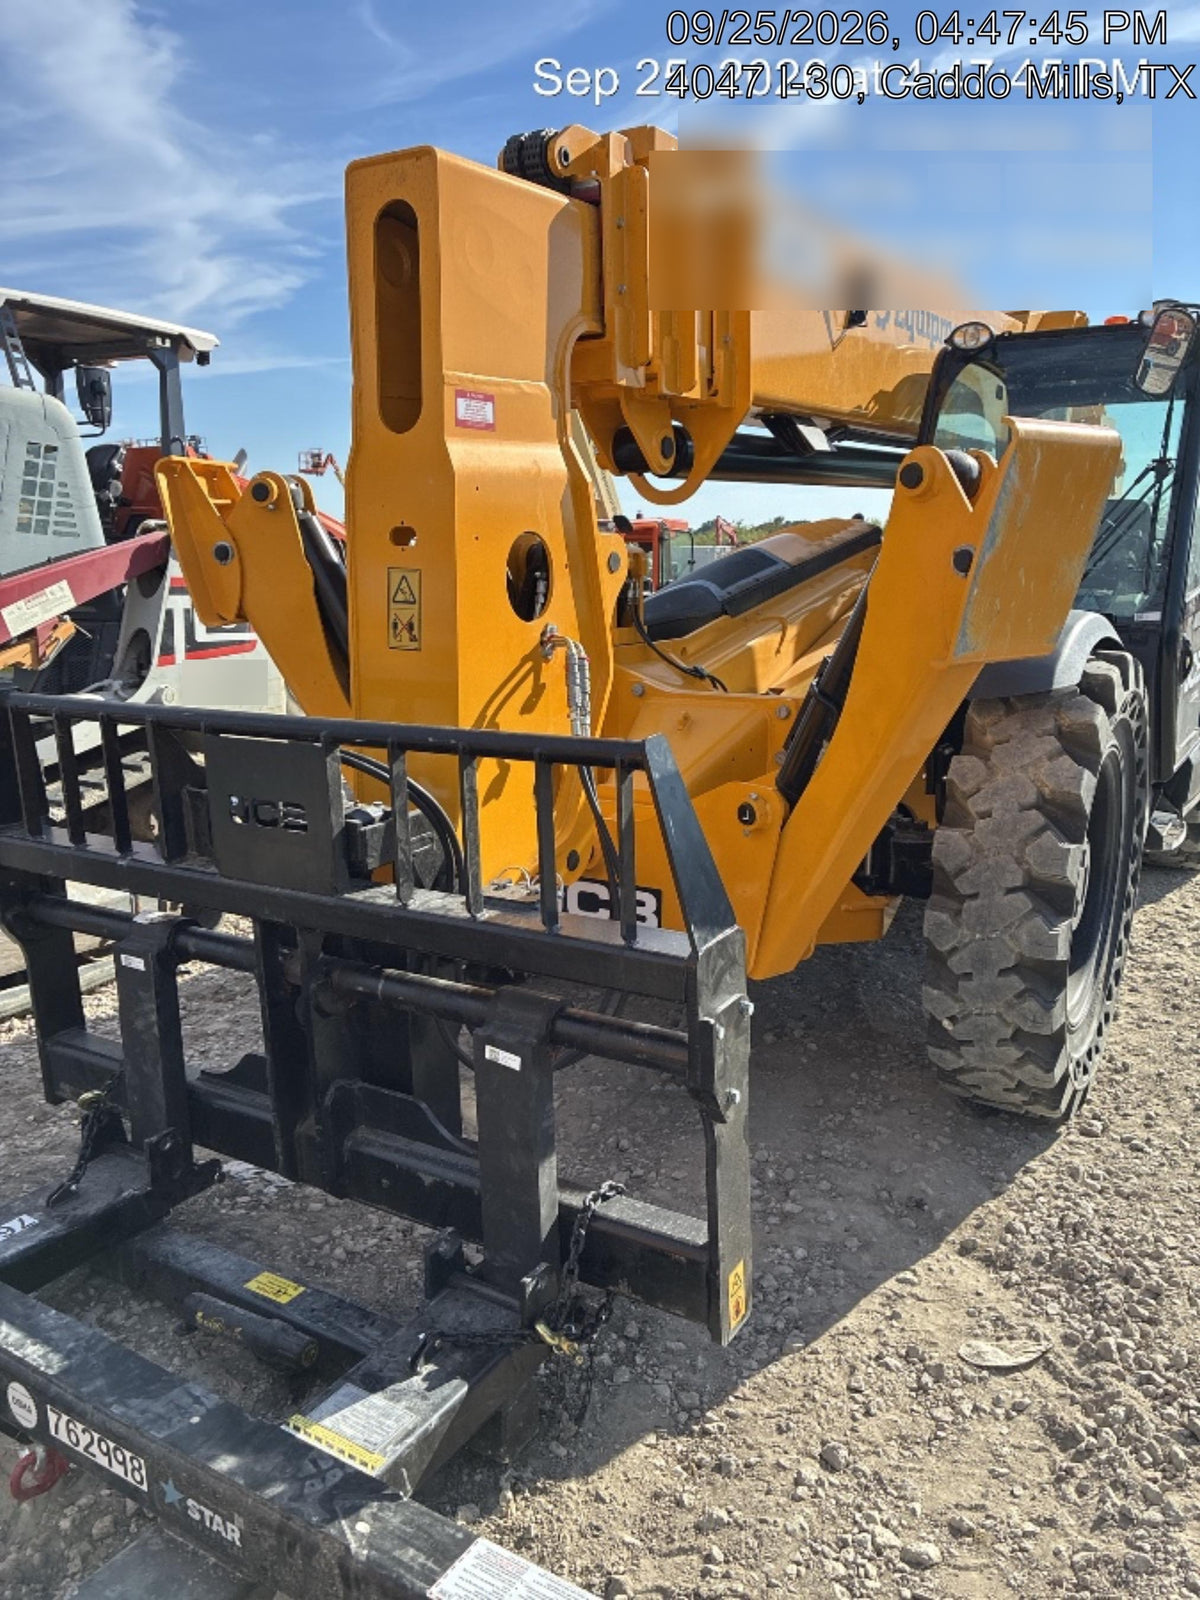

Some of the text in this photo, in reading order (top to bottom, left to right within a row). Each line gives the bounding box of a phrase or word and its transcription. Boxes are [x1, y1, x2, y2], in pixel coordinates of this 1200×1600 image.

[229, 795, 308, 834] JCB
[49, 1408, 147, 1487] 762998
[186, 1497, 242, 1548] STAR
